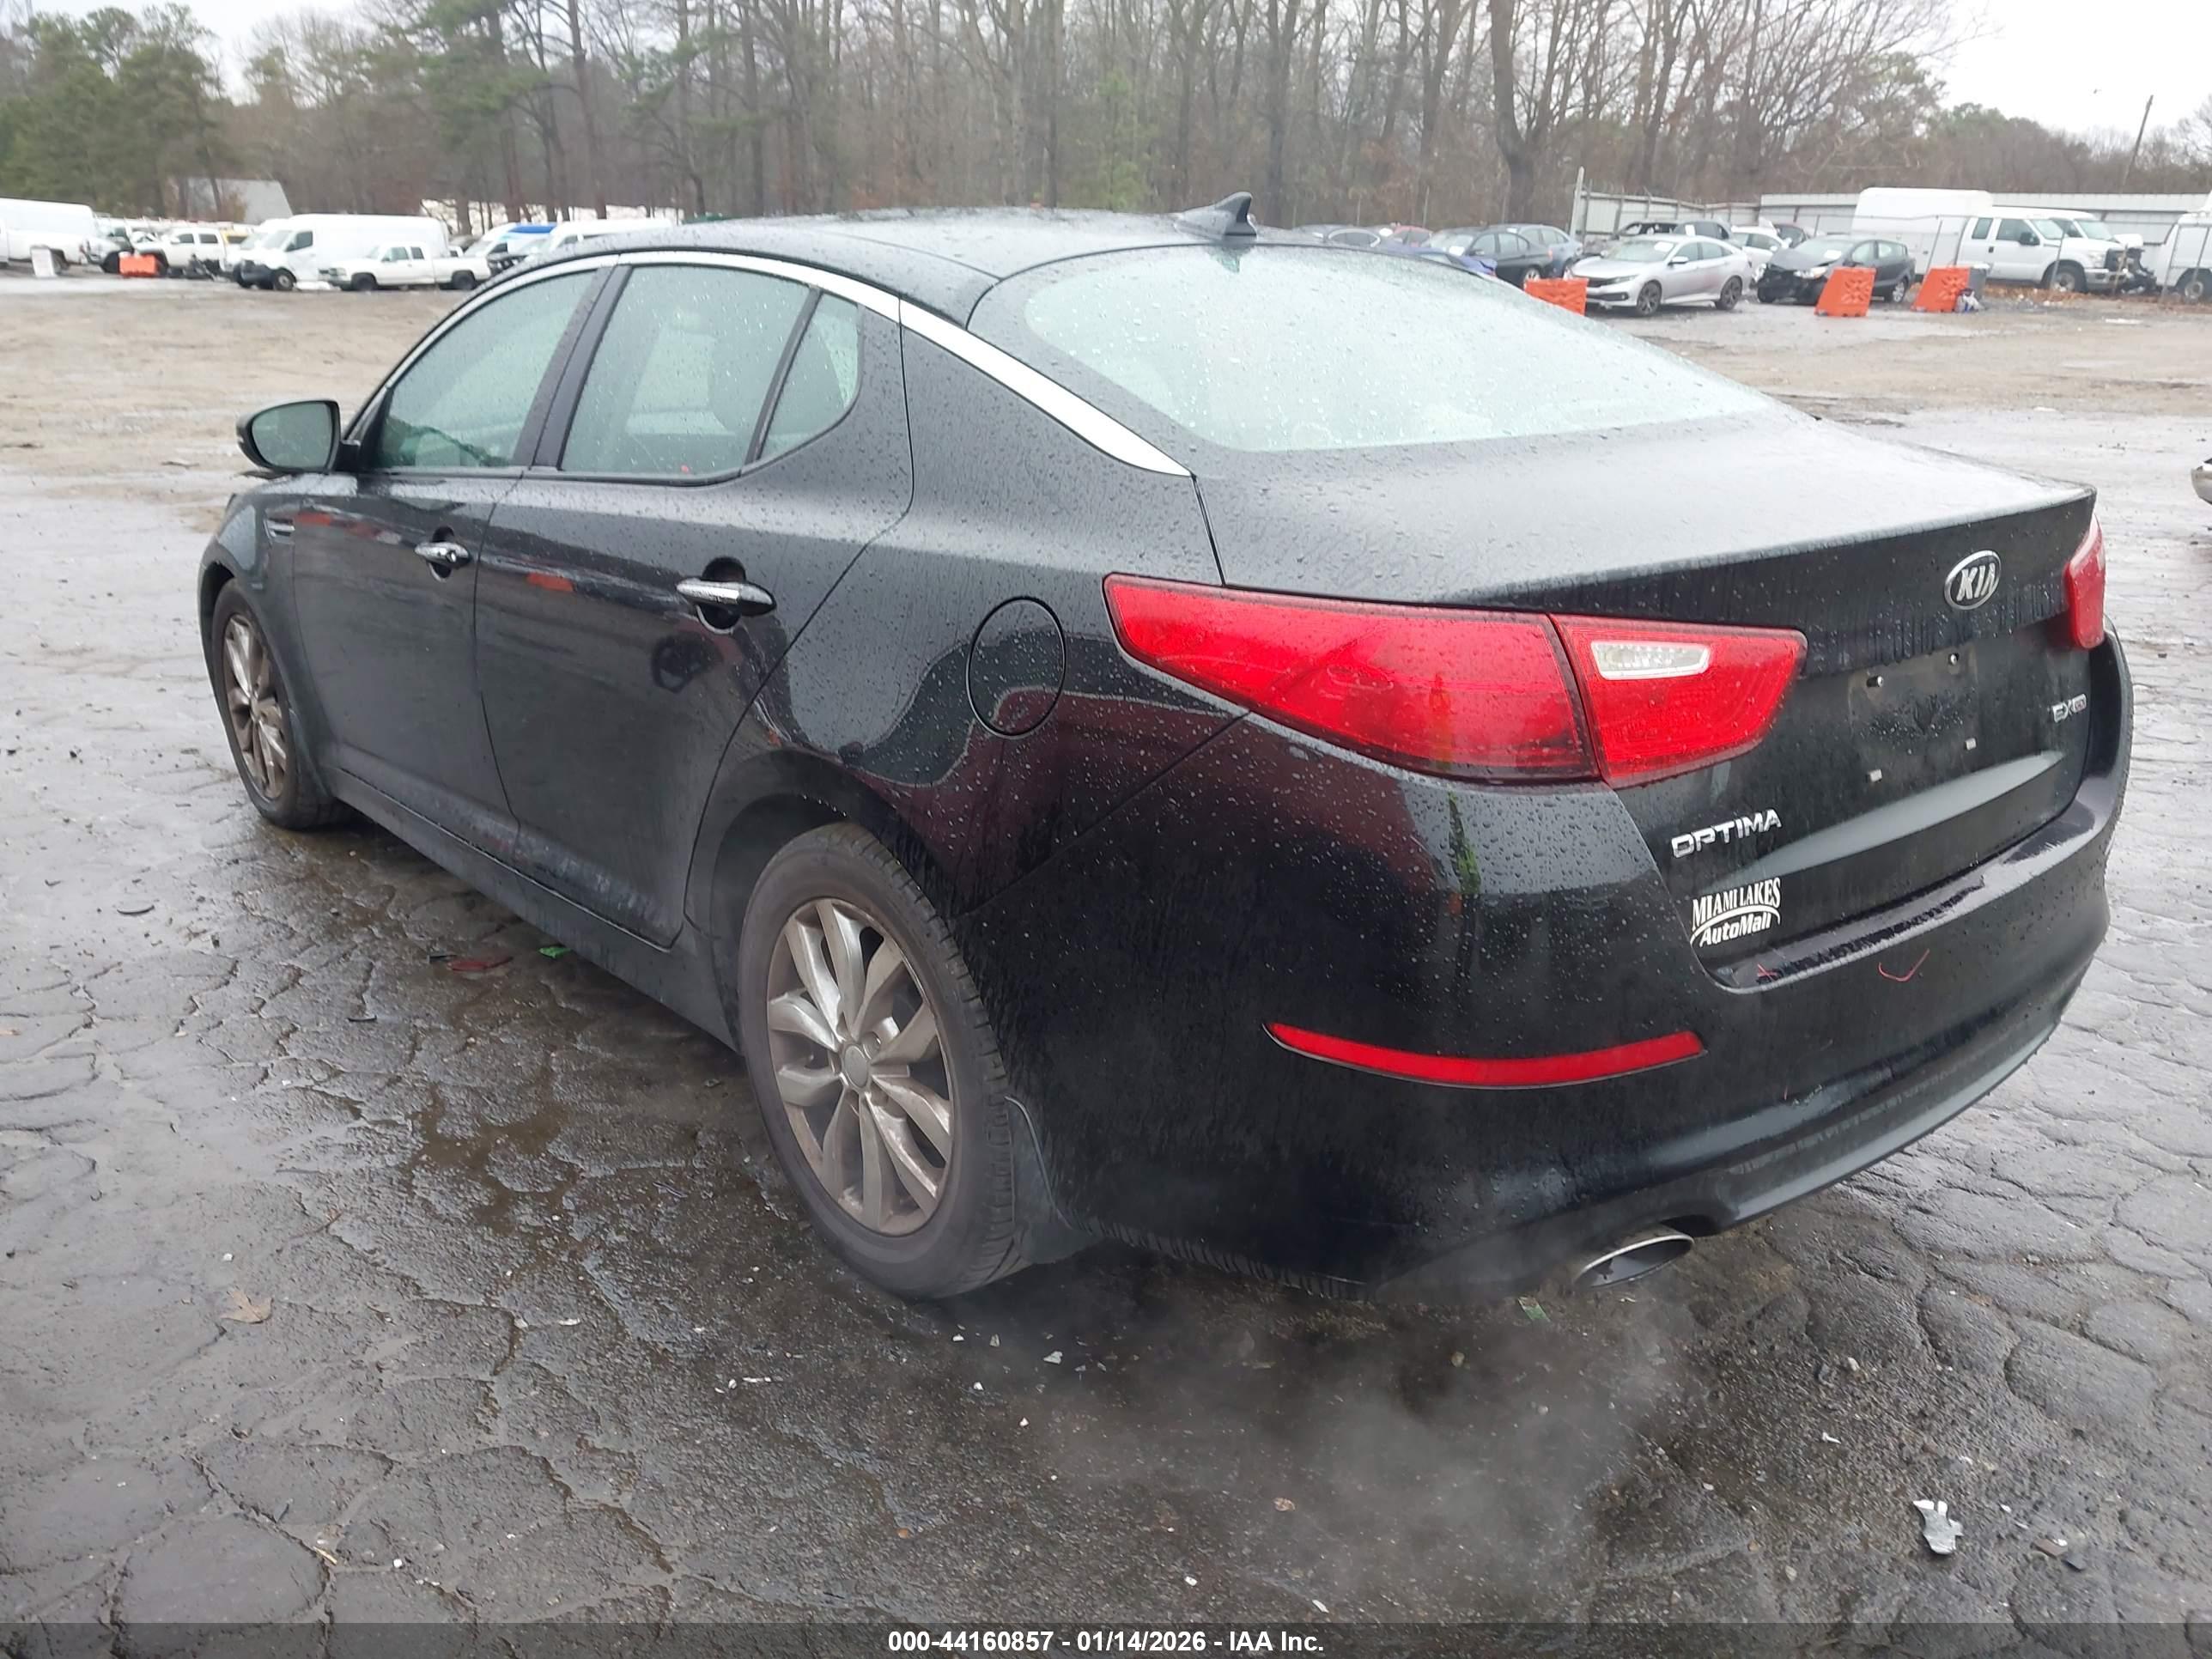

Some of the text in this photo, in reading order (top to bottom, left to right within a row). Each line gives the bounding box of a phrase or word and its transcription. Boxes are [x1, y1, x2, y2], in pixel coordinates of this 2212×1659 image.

[1956, 562, 1996, 601] KIA
[1671, 809, 1782, 858] OPTIMA
[1692, 877, 1781, 932] MIAMI LAKES
[1698, 911, 1771, 948] AutoMall
